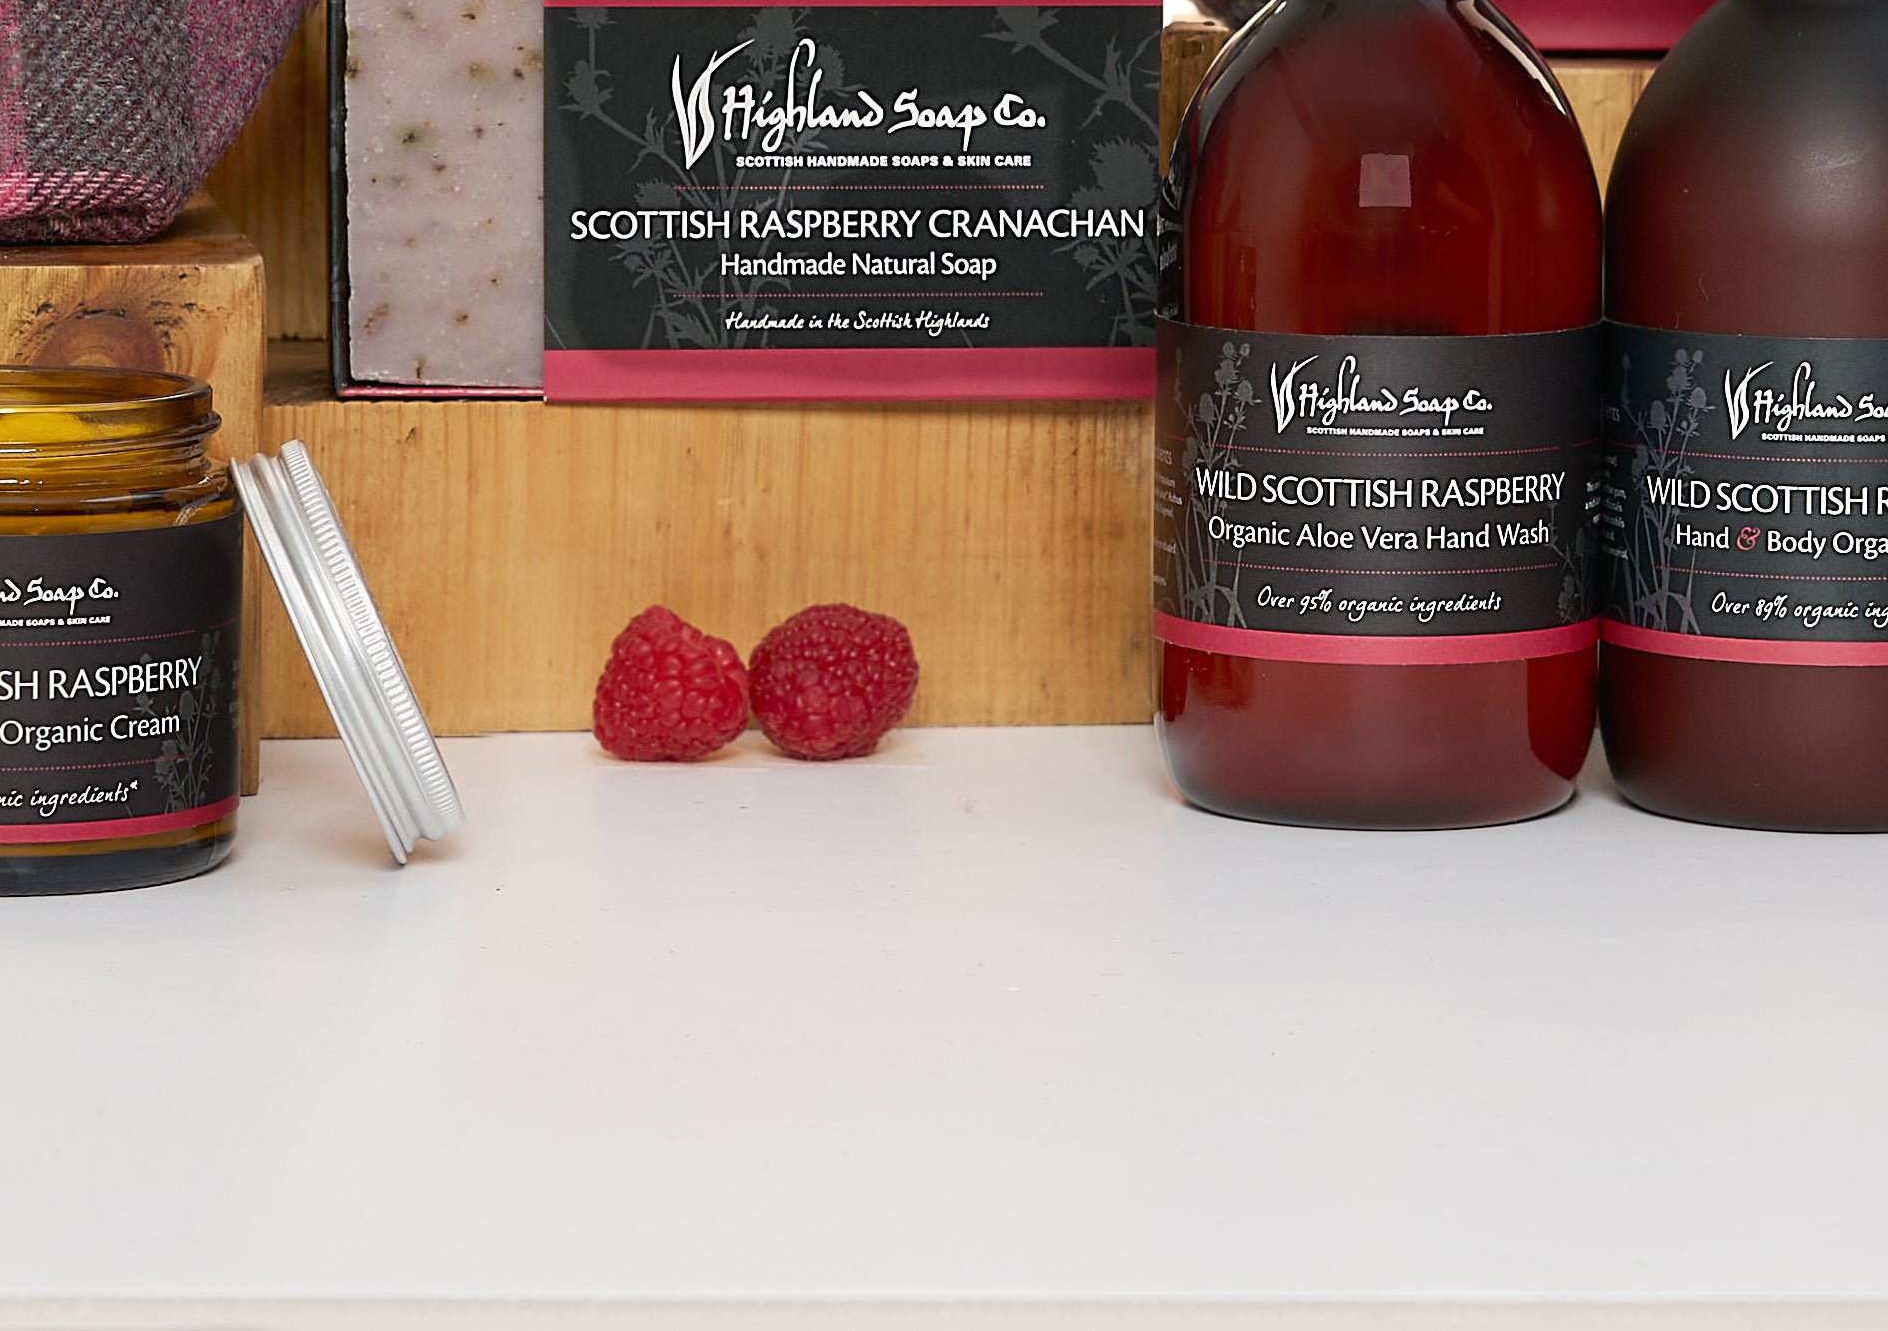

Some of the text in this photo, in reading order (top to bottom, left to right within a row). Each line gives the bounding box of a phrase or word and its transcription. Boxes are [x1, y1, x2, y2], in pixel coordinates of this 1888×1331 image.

[570, 208, 1144, 240] SCOTTISH RASPBERRY CRANACHAN
[721, 251, 997, 281] Handmade Natural Soap
[725, 310, 990, 337] Handmade in the Scottish Highlands
[1208, 515, 1549, 550] Organic Aloe Vera Hand Wash
[1676, 523, 1730, 549] Hand
[1736, 526, 1761, 551] &
[1767, 530, 1827, 560] Body
[1257, 585, 1502, 623] Over 95% organic ingredients
[1711, 591, 1750, 614] Over
[1755, 594, 1788, 621] 89%
[1793, 602, 1859, 628] organic
[0, 717, 104, 752] Organic
[110, 714, 180, 740] Cream
